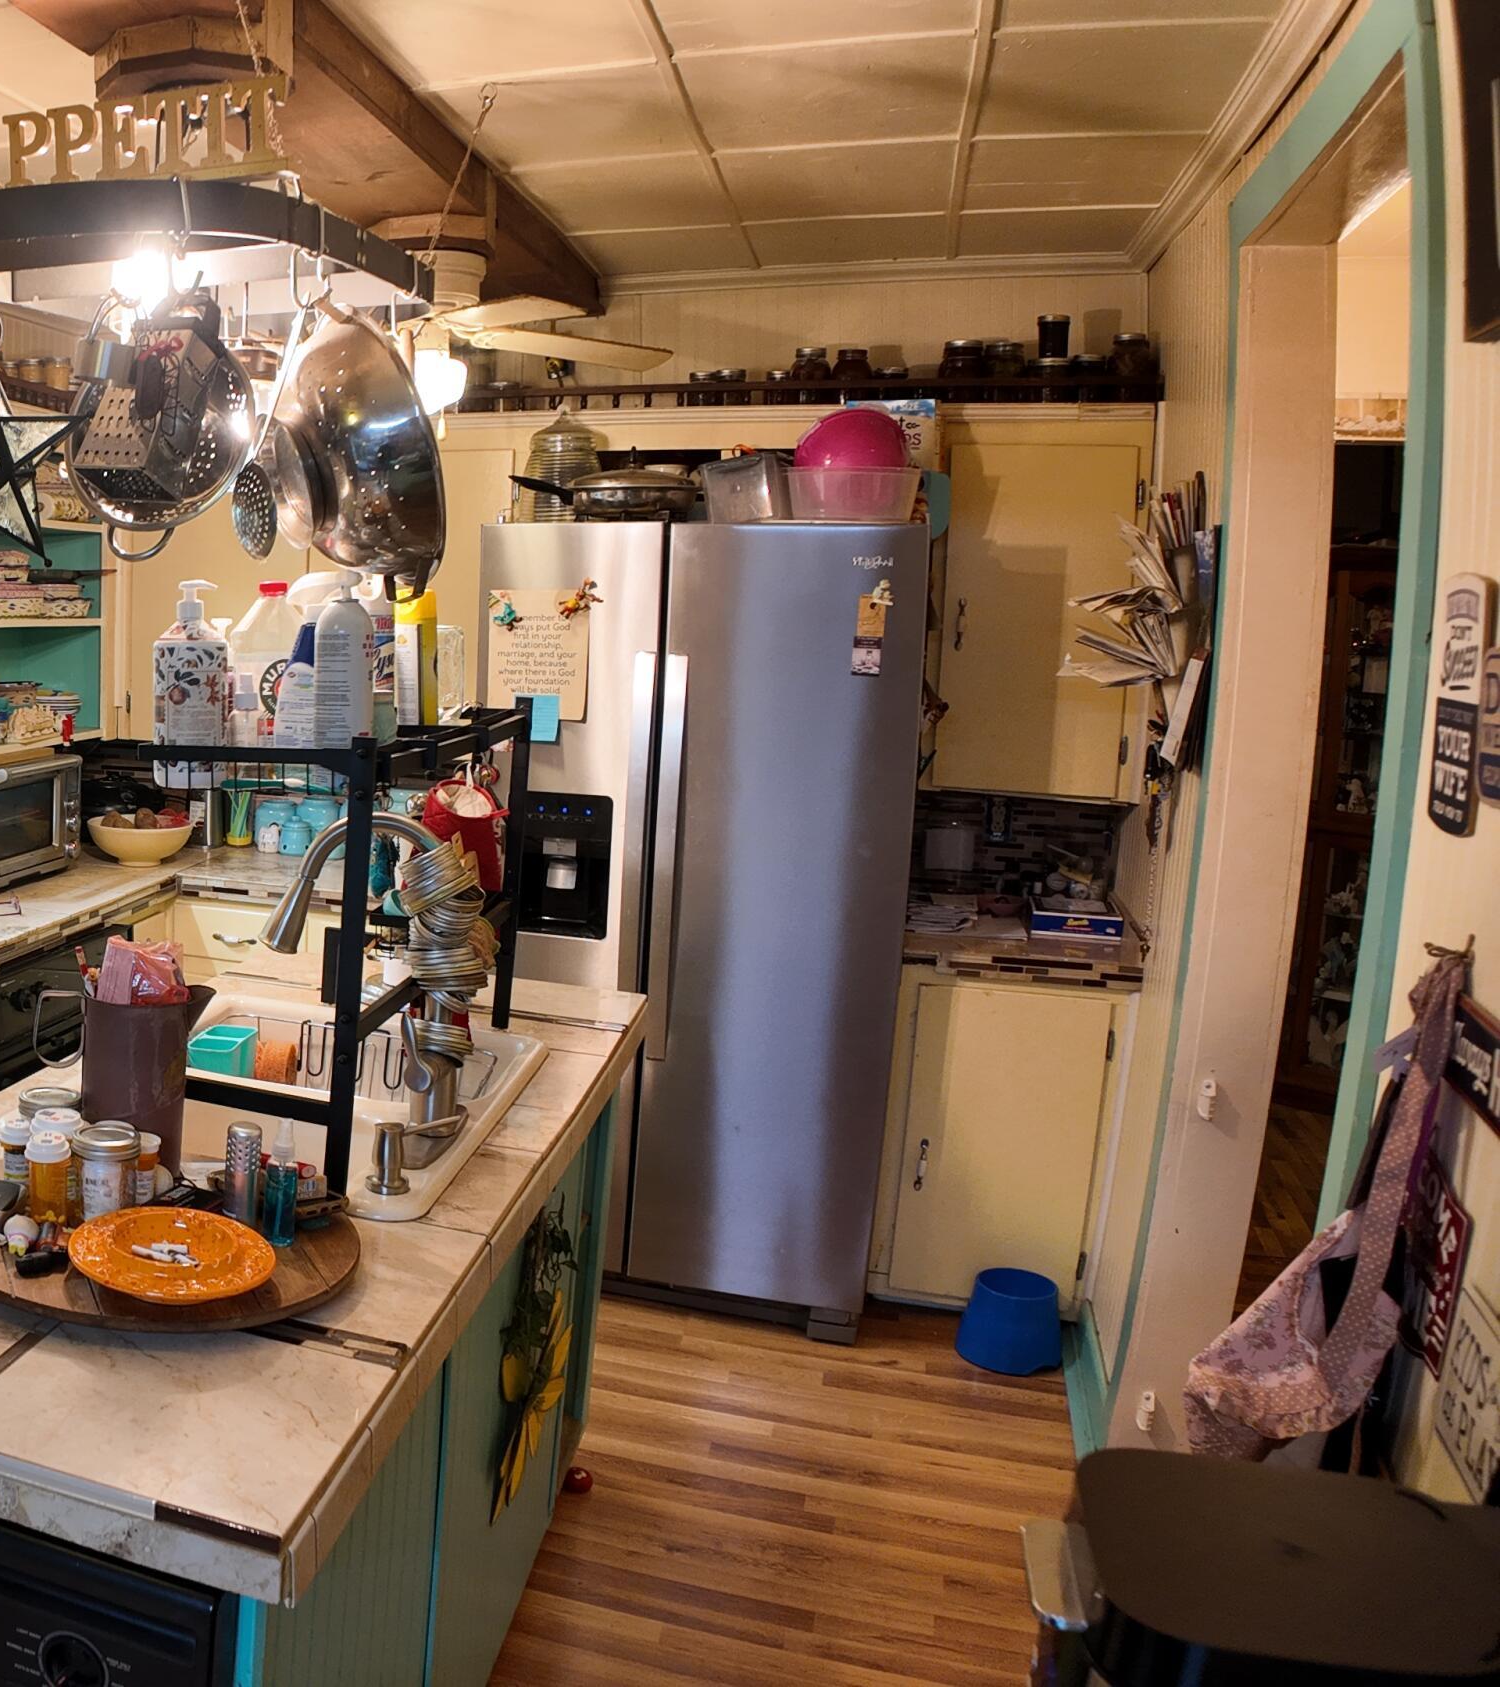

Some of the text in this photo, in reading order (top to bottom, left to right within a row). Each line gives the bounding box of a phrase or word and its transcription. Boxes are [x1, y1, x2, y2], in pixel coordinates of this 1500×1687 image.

[536, 624, 551, 632] put
[553, 623, 571, 631] God
[513, 632, 562, 642] first in your
[557, 652, 577, 660] your
[533, 659, 568, 667] because
[549, 668, 556, 676] is
[558, 668, 576, 677] God
[503, 677, 570, 686] your foundation
[527, 686, 538, 694] be
[1437, 724, 1471, 763] YOUR
[1434, 759, 1469, 802] WIFE
[1450, 1318, 1491, 1410] KIDS
[1457, 1401, 1496, 1492] PLA
